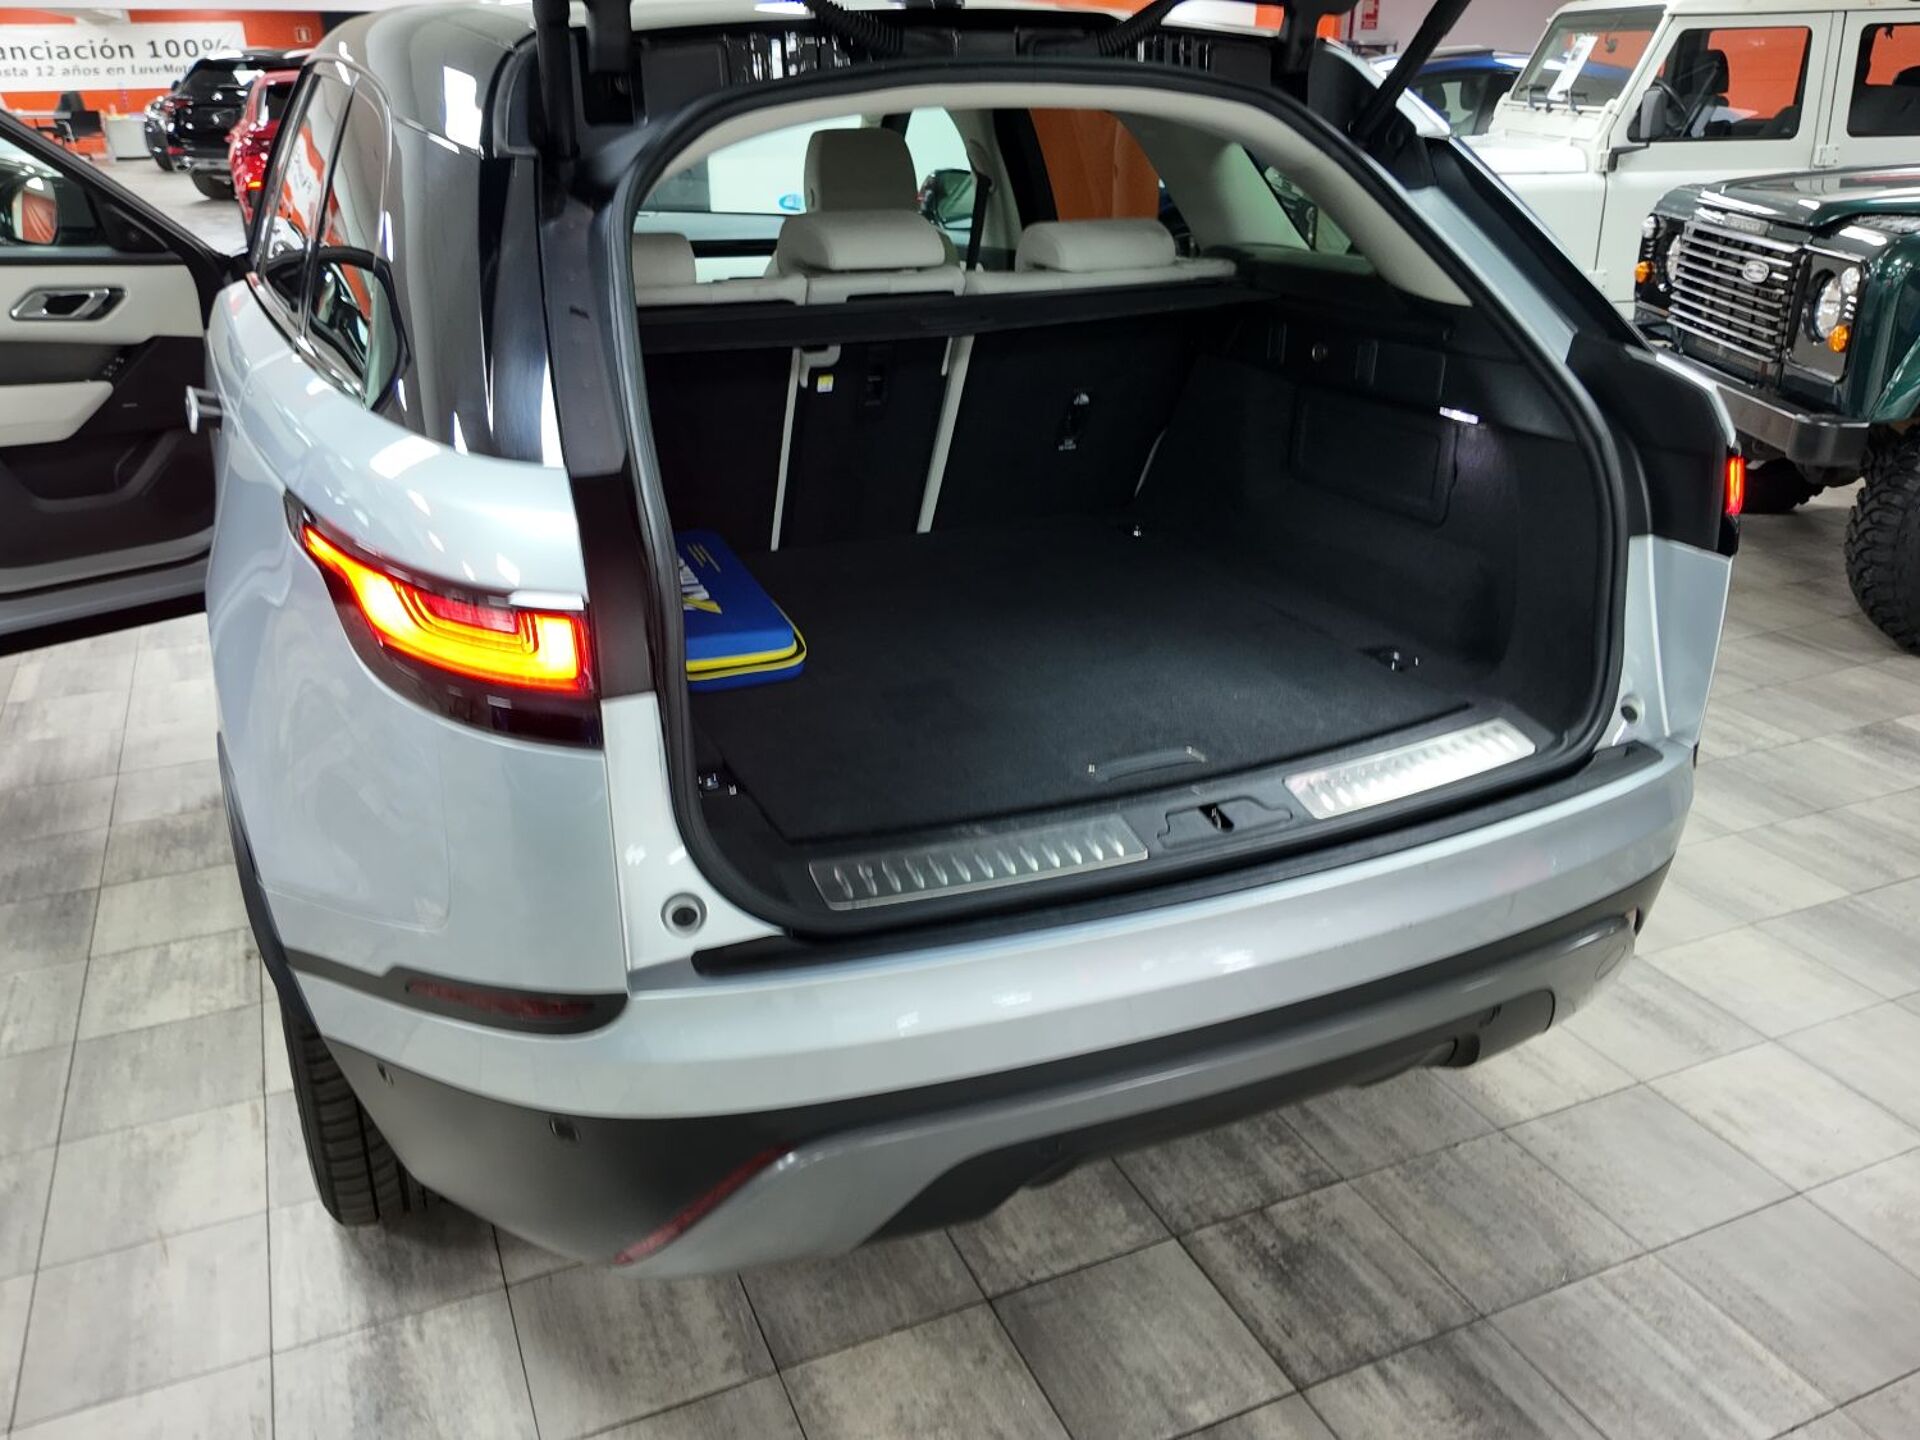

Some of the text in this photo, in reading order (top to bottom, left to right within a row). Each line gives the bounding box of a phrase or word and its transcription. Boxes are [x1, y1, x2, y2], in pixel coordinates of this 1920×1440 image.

[0, 66, 28, 77] sta
[36, 66, 55, 77] 12
[106, 66, 126, 76] en
